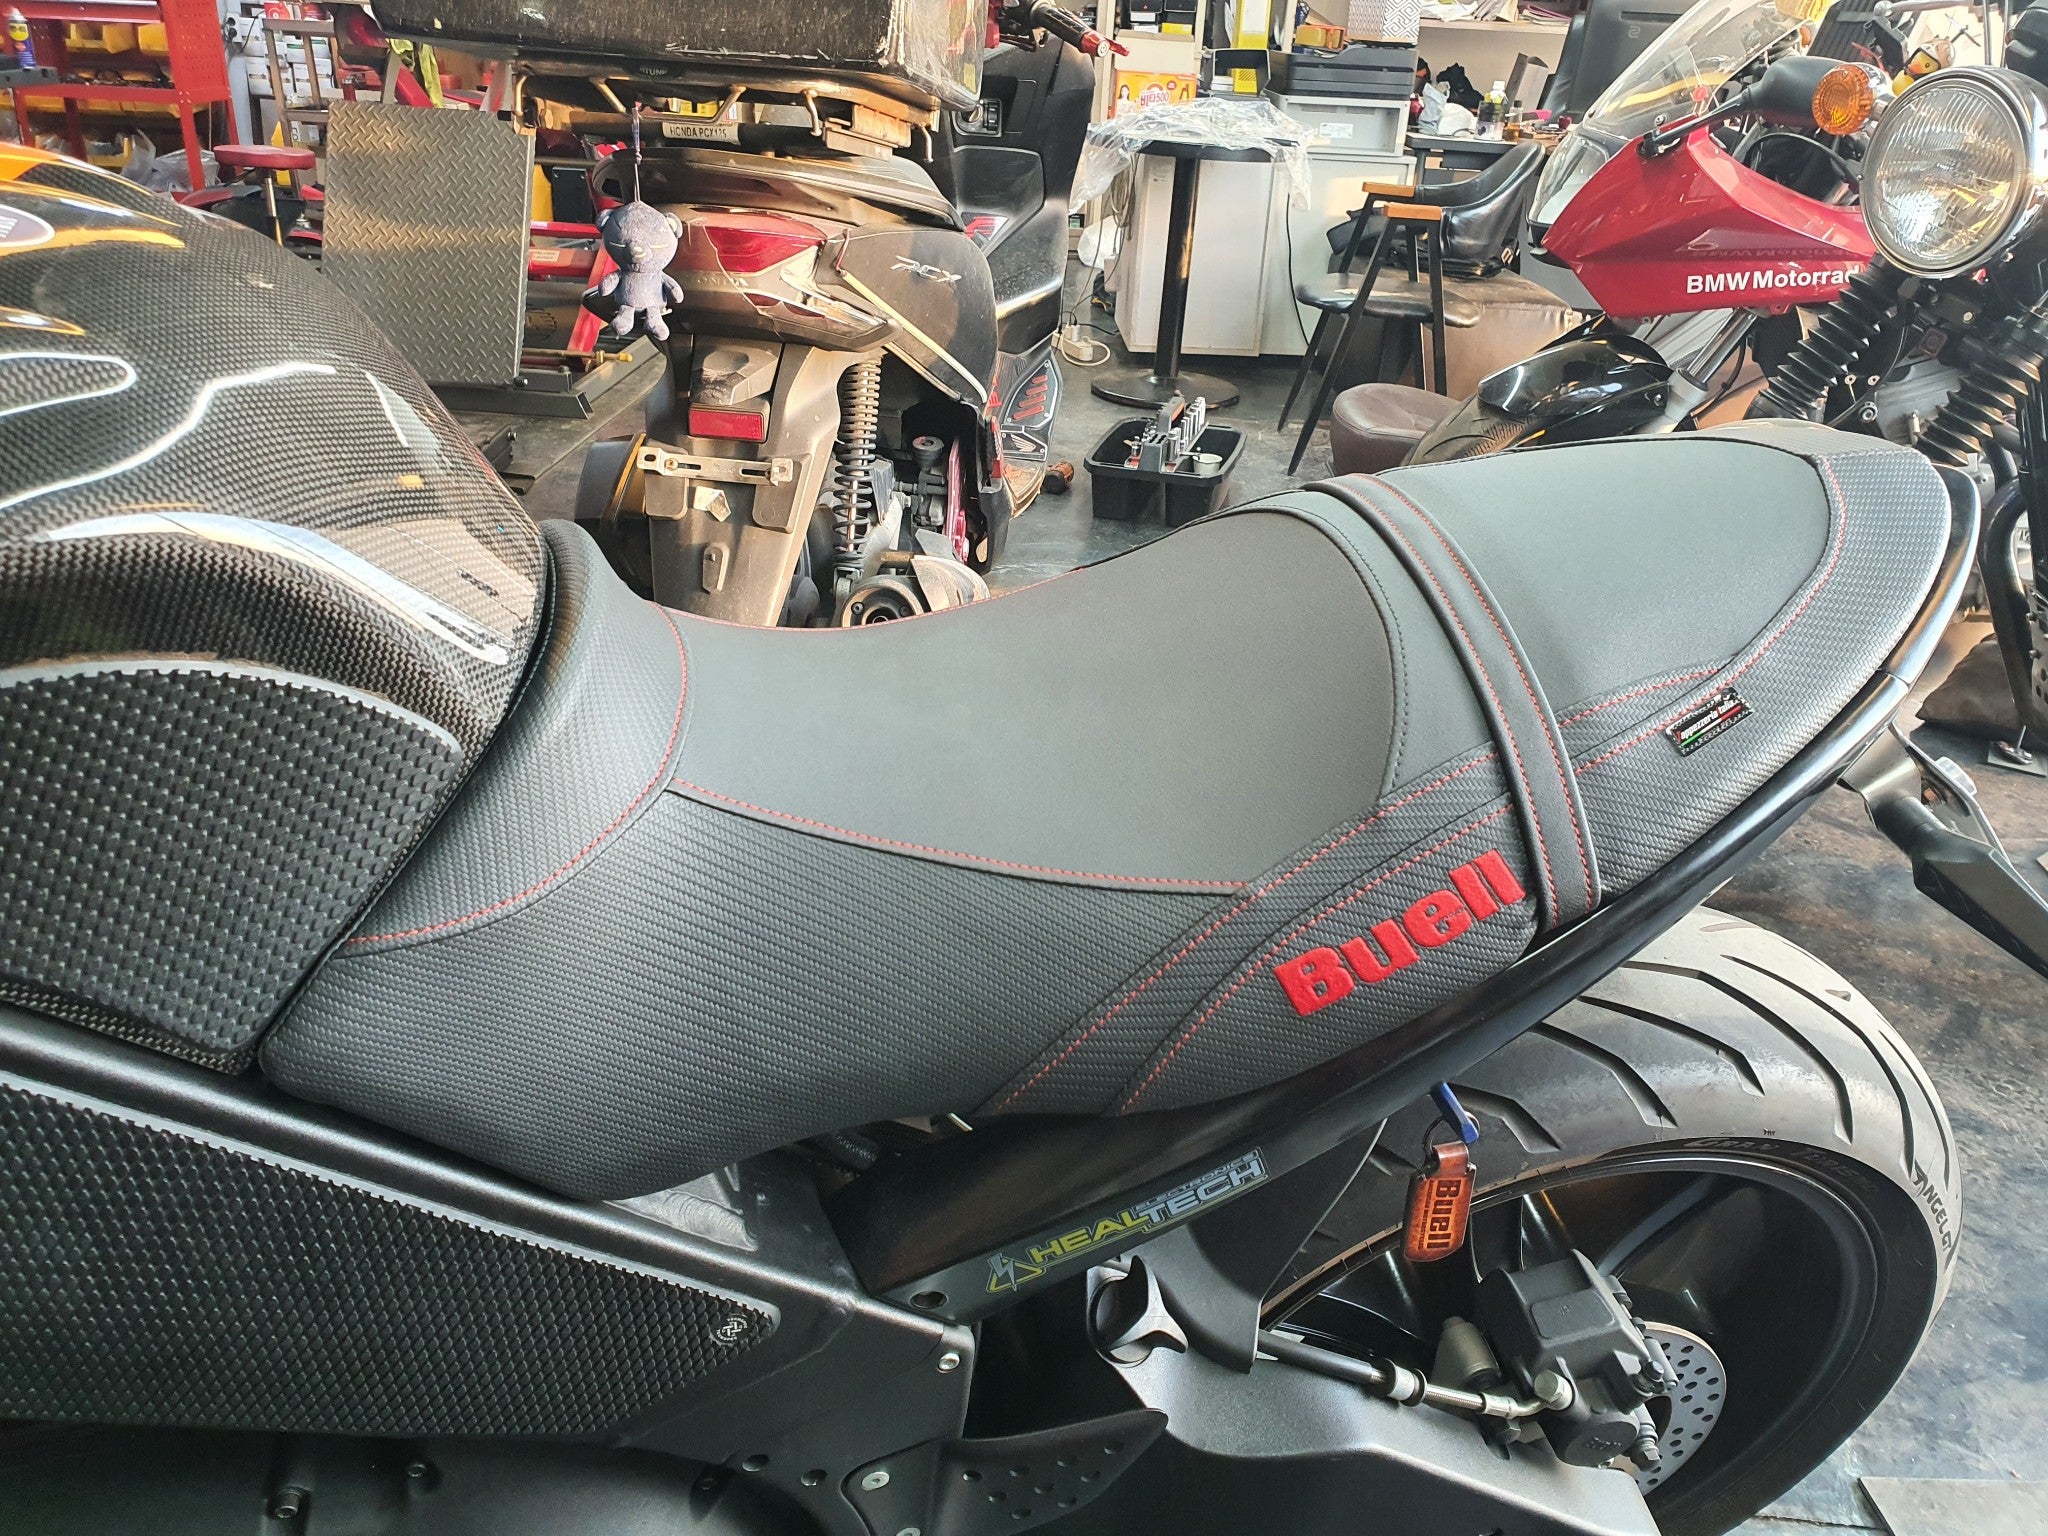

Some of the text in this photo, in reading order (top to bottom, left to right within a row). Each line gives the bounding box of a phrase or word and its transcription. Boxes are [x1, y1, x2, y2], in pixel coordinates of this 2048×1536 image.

[670, 126, 697, 137] HONDA
[889, 255, 962, 284] PCX
[1686, 264, 1859, 294] BMW Motorrad
[1273, 848, 1526, 1017] Buell
[1427, 1179, 1461, 1249] Buell
[1912, 1158, 1949, 1235] ANGEL
